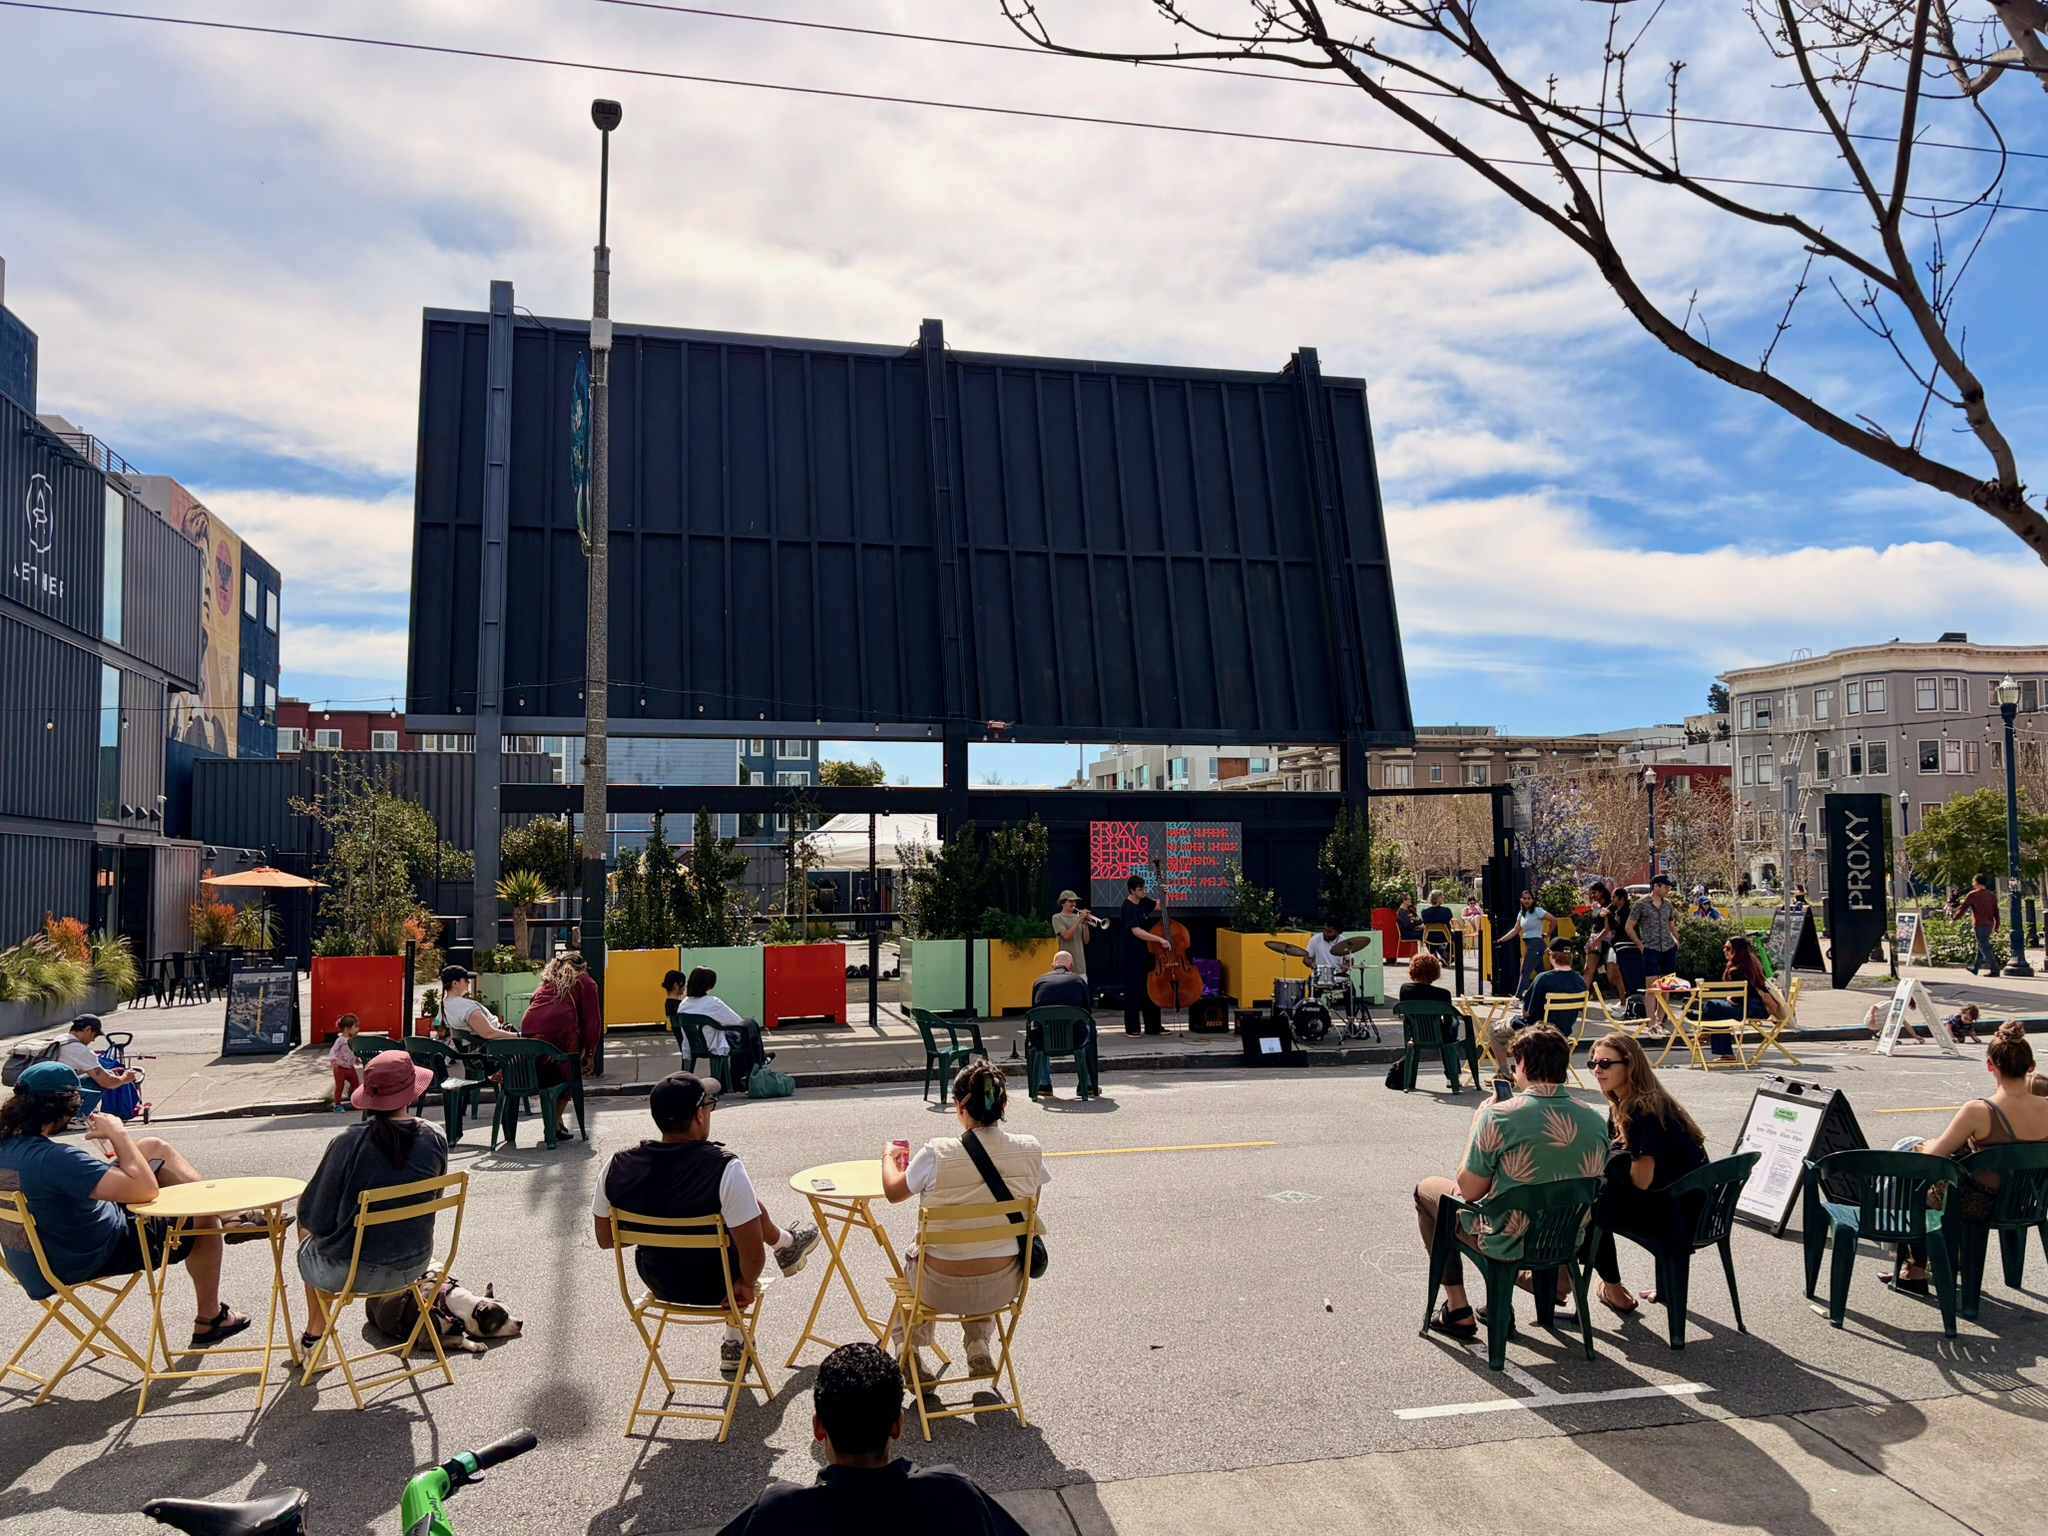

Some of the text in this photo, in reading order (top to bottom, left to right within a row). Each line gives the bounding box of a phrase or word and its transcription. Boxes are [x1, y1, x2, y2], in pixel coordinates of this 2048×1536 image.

[1090, 821, 1139, 837] PROXY
[1194, 828, 1228, 838] SUPREME
[1090, 835, 1149, 851] SPRING
[1181, 842, 1205, 851] OTHER
[1208, 842, 1238, 852] CHOICE
[1090, 850, 1149, 865] SERIES
[1166, 856, 1220, 865] SENTIMENTAL
[1844, 810, 1873, 910] PROXY
[1166, 877, 1196, 887] LITTLE
